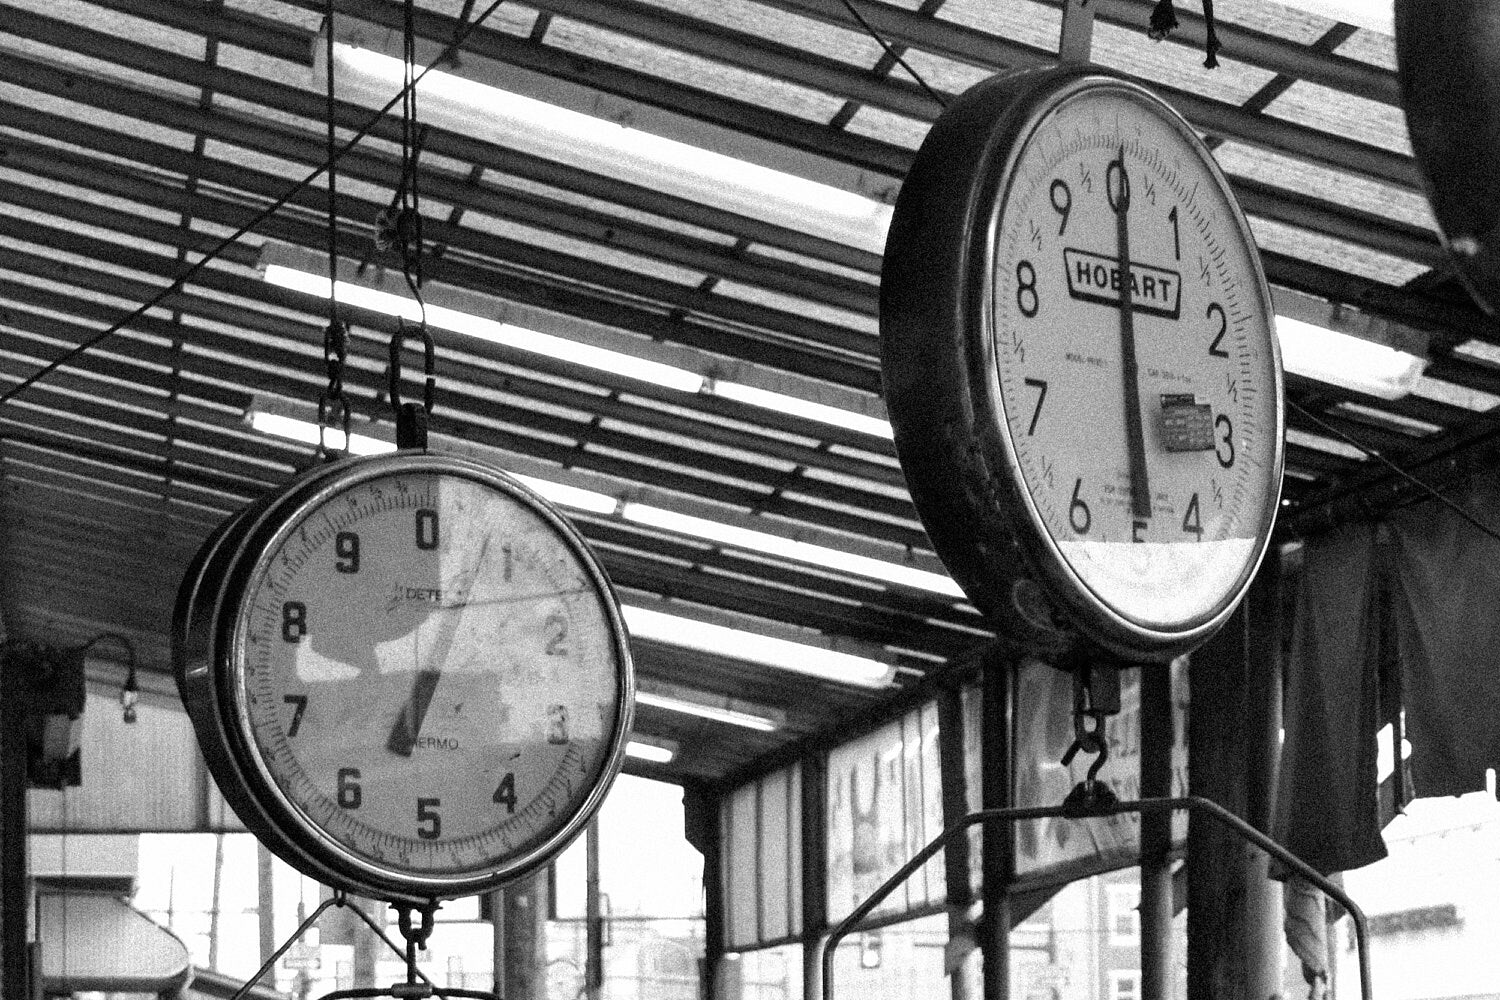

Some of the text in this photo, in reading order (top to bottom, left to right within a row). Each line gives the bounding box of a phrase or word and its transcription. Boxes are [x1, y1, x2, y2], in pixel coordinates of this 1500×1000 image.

[1050, 178, 1073, 237] 9
[1167, 205, 1181, 261] 1
[1016, 260, 1039, 319] 8
[1075, 260, 1173, 302] HOBART
[1205, 302, 1229, 359] 2
[1025, 378, 1049, 437] 7
[1215, 413, 1235, 469] 3
[414, 508, 439, 551] 0
[1068, 477, 1092, 535] 6
[1182, 492, 1205, 544] 4
[335, 531, 361, 574] 9
[282, 600, 307, 643] 8
[283, 694, 309, 738] 7
[337, 766, 362, 810] 6
[493, 771, 518, 814] 4
[416, 797, 441, 840] 5
